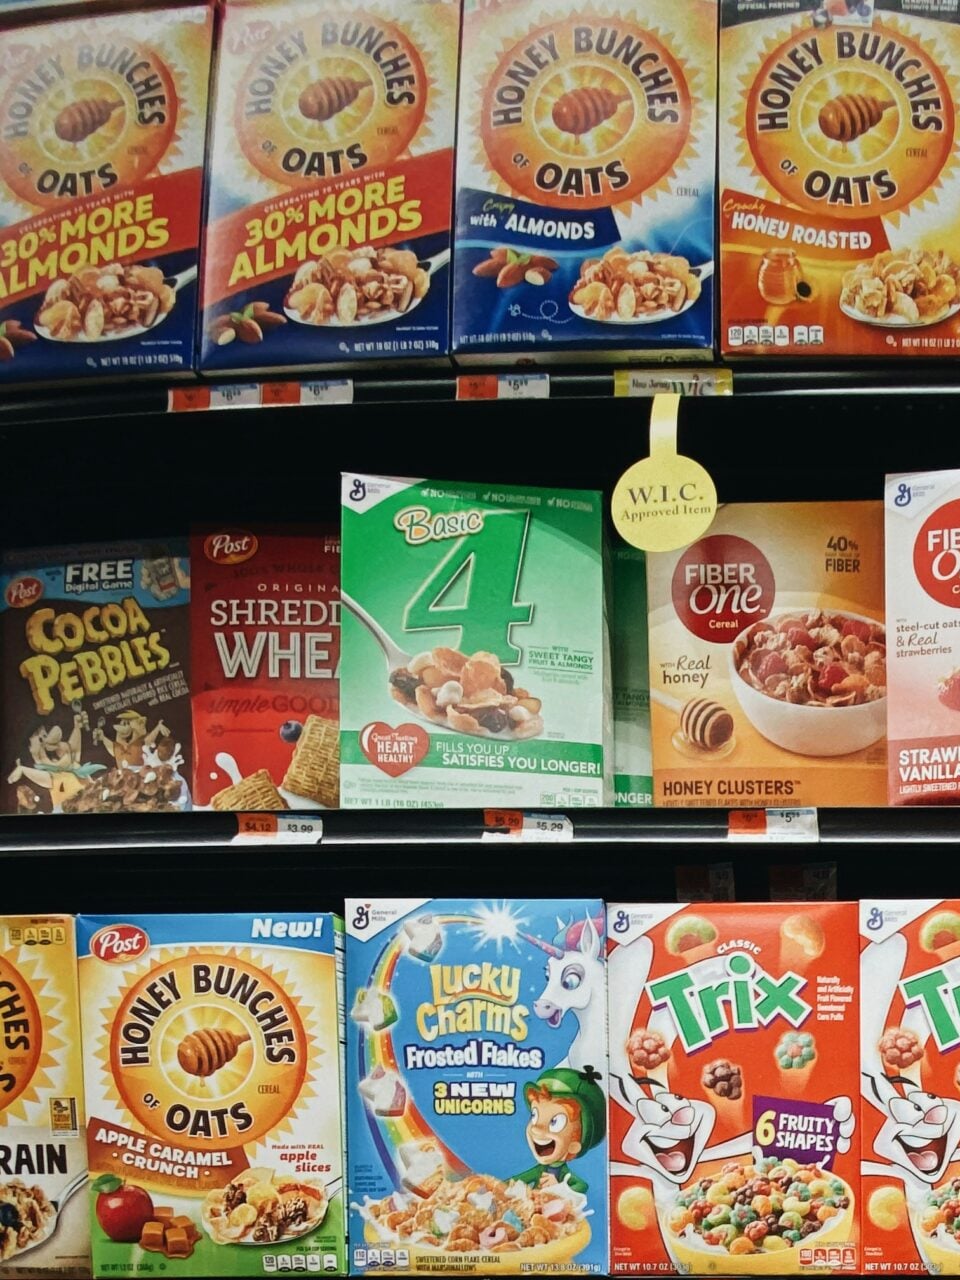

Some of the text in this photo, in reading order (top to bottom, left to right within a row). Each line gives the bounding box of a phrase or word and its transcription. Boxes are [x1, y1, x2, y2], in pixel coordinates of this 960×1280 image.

[37, 162, 118, 197] OATS
[244, 207, 304, 248] 30%
[308, 175, 406, 226] MORE
[732, 212, 872, 250] HONEY ROASTED
[228, 199, 422, 287] ALMONDS
[629, 483, 704, 506] W.I.C.
[621, 504, 711, 522] Approved Item
[396, 507, 483, 544] Basic
[212, 534, 250, 558] Post
[66, 560, 133, 582] FREE
[685, 563, 756, 585] FIBER
[825, 558, 860, 573] FIBER
[402, 508, 534, 666] 4
[709, 619, 739, 629] Cereal
[663, 671, 709, 688] honey
[377, 741, 413, 753] HEART
[377, 753, 413, 763] HEALTHY
[436, 742, 509, 755] FILLS YOU UP
[442, 754, 601, 774] SATISFIES YOU LONGER!
[251, 918, 323, 937] New!
[716, 939, 762, 955] CLASSIC
[647, 953, 812, 1053] Trix
[416, 1000, 530, 1042] Charms
[406, 1040, 543, 1069] Frosted Flakes
[434, 1082, 516, 1098] 3 NEW
[434, 1098, 516, 1115] UNICORNS
[756, 1110, 836, 1147] 6 FRUITY
[95, 1128, 232, 1167] APPLE CARAMEL
[776, 1133, 834, 1152] SHAPES
[122, 1154, 199, 1179] CRUNCH
[279, 1152, 317, 1165] apple
[295, 1162, 331, 1173] slices
